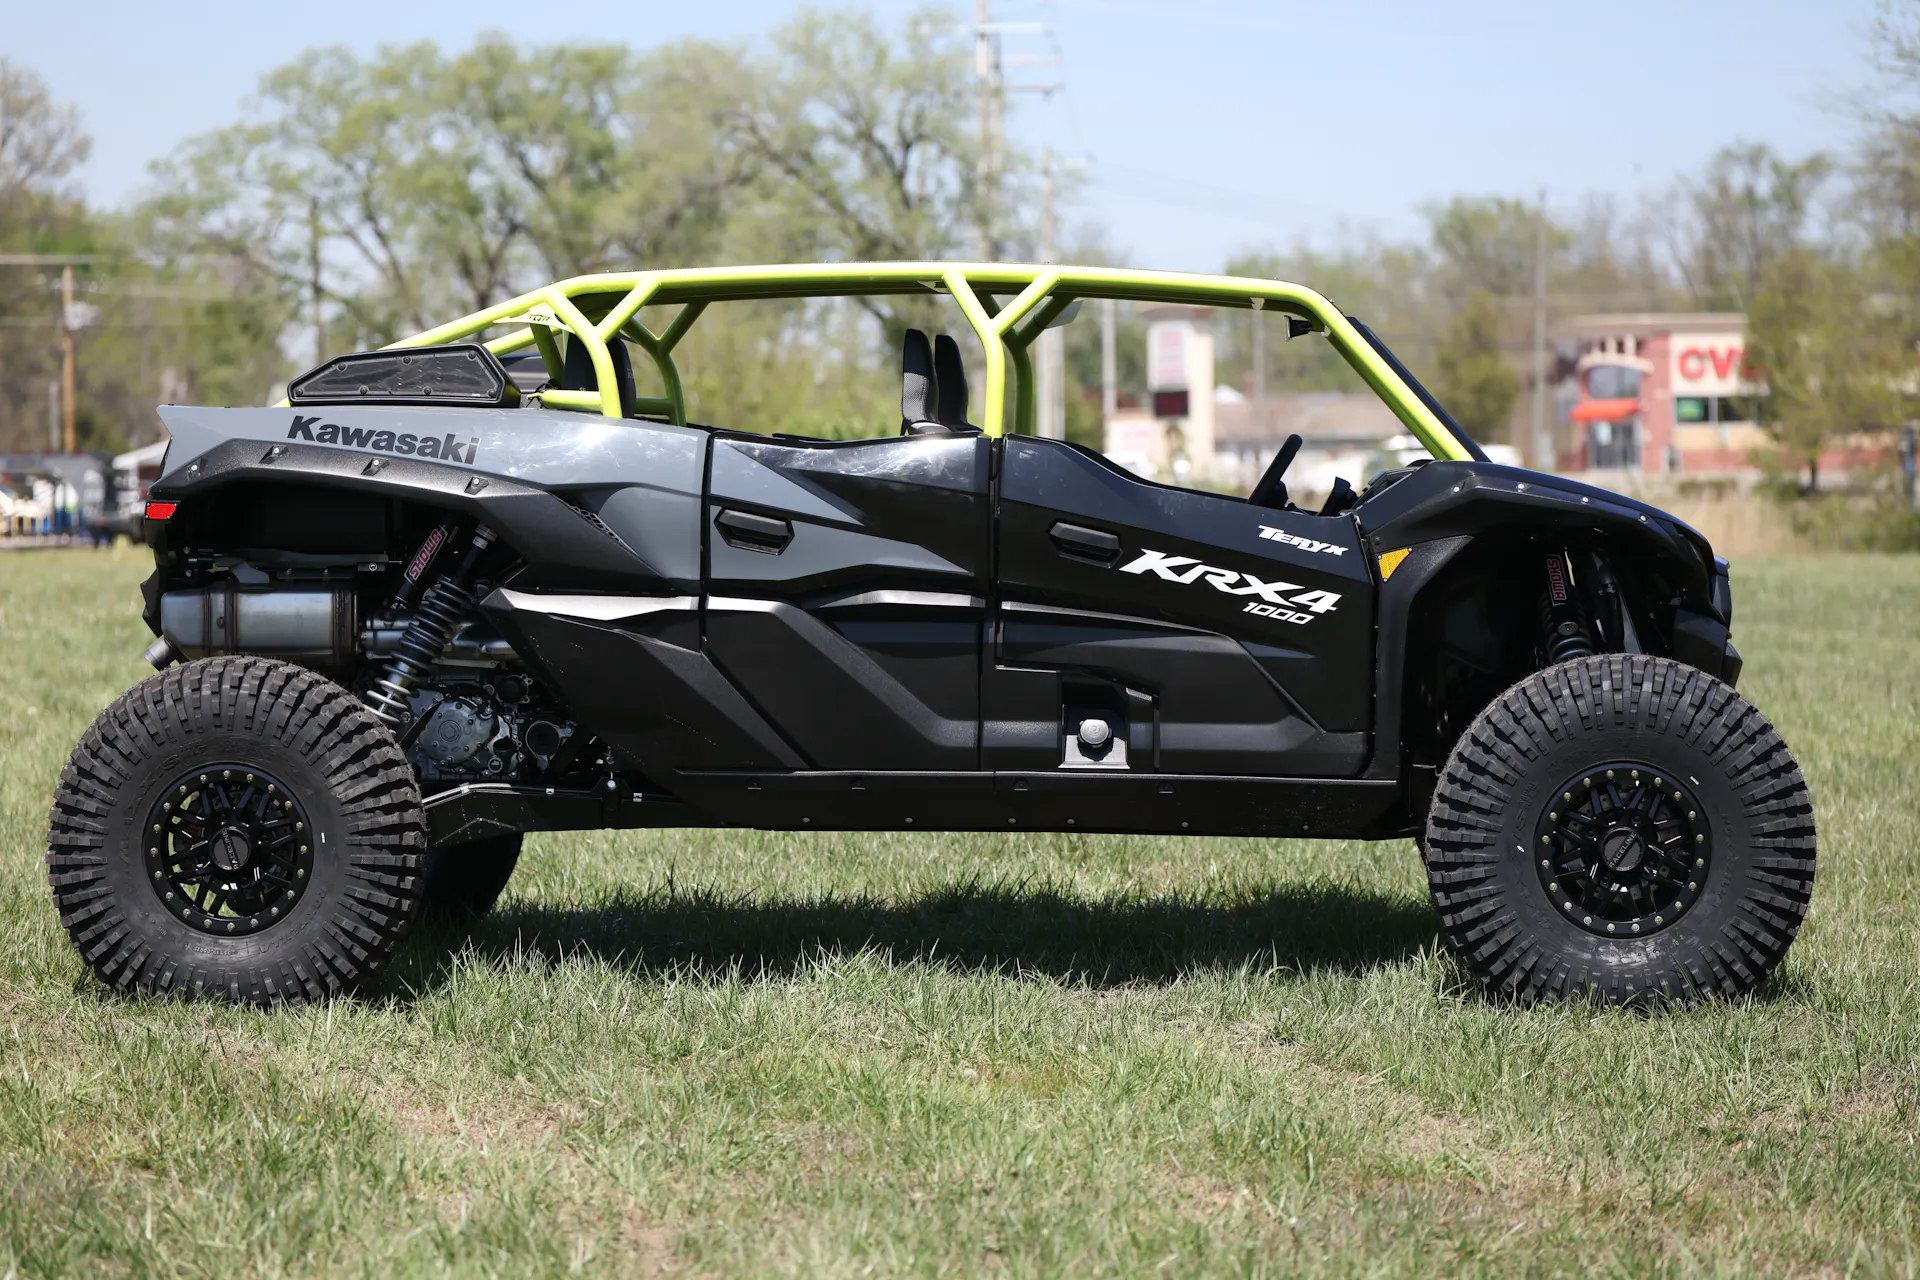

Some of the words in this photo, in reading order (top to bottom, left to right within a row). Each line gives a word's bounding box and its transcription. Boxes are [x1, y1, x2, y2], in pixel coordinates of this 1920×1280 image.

[287, 415, 481, 465] Kawasaki
[408, 528, 443, 581] SHOWA
[1119, 548, 1342, 614] KRX4
[1547, 559, 1567, 600] SHOWA
[1242, 602, 1315, 624] 1000
[1608, 831, 1637, 869] RACELINE
